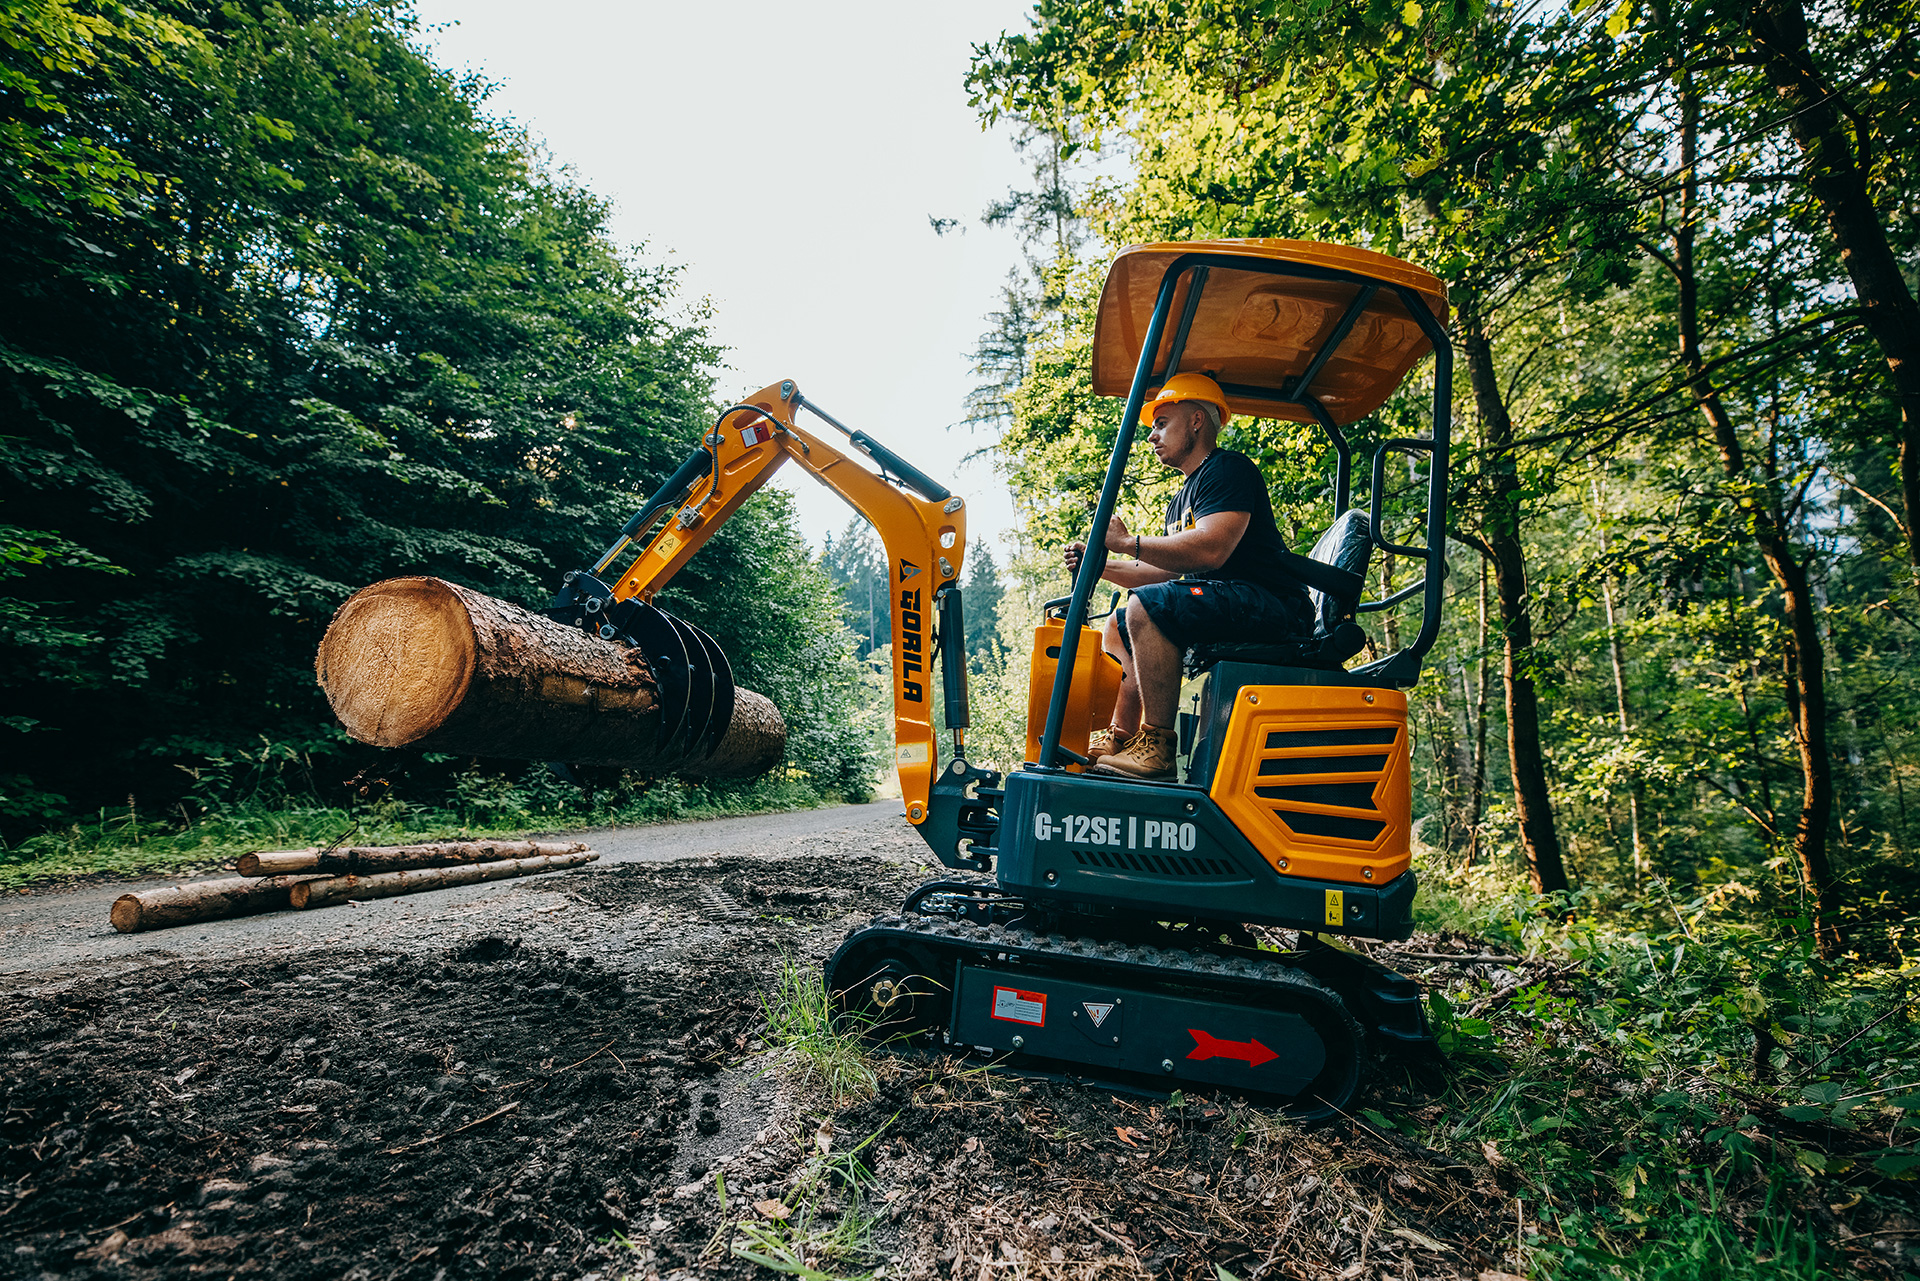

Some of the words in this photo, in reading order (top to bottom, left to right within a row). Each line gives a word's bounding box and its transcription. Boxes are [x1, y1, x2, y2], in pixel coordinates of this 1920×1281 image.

[900, 587, 923, 703] GORILA
[1034, 812, 1121, 846] G-12SE
[1144, 820, 1197, 852] PRO
